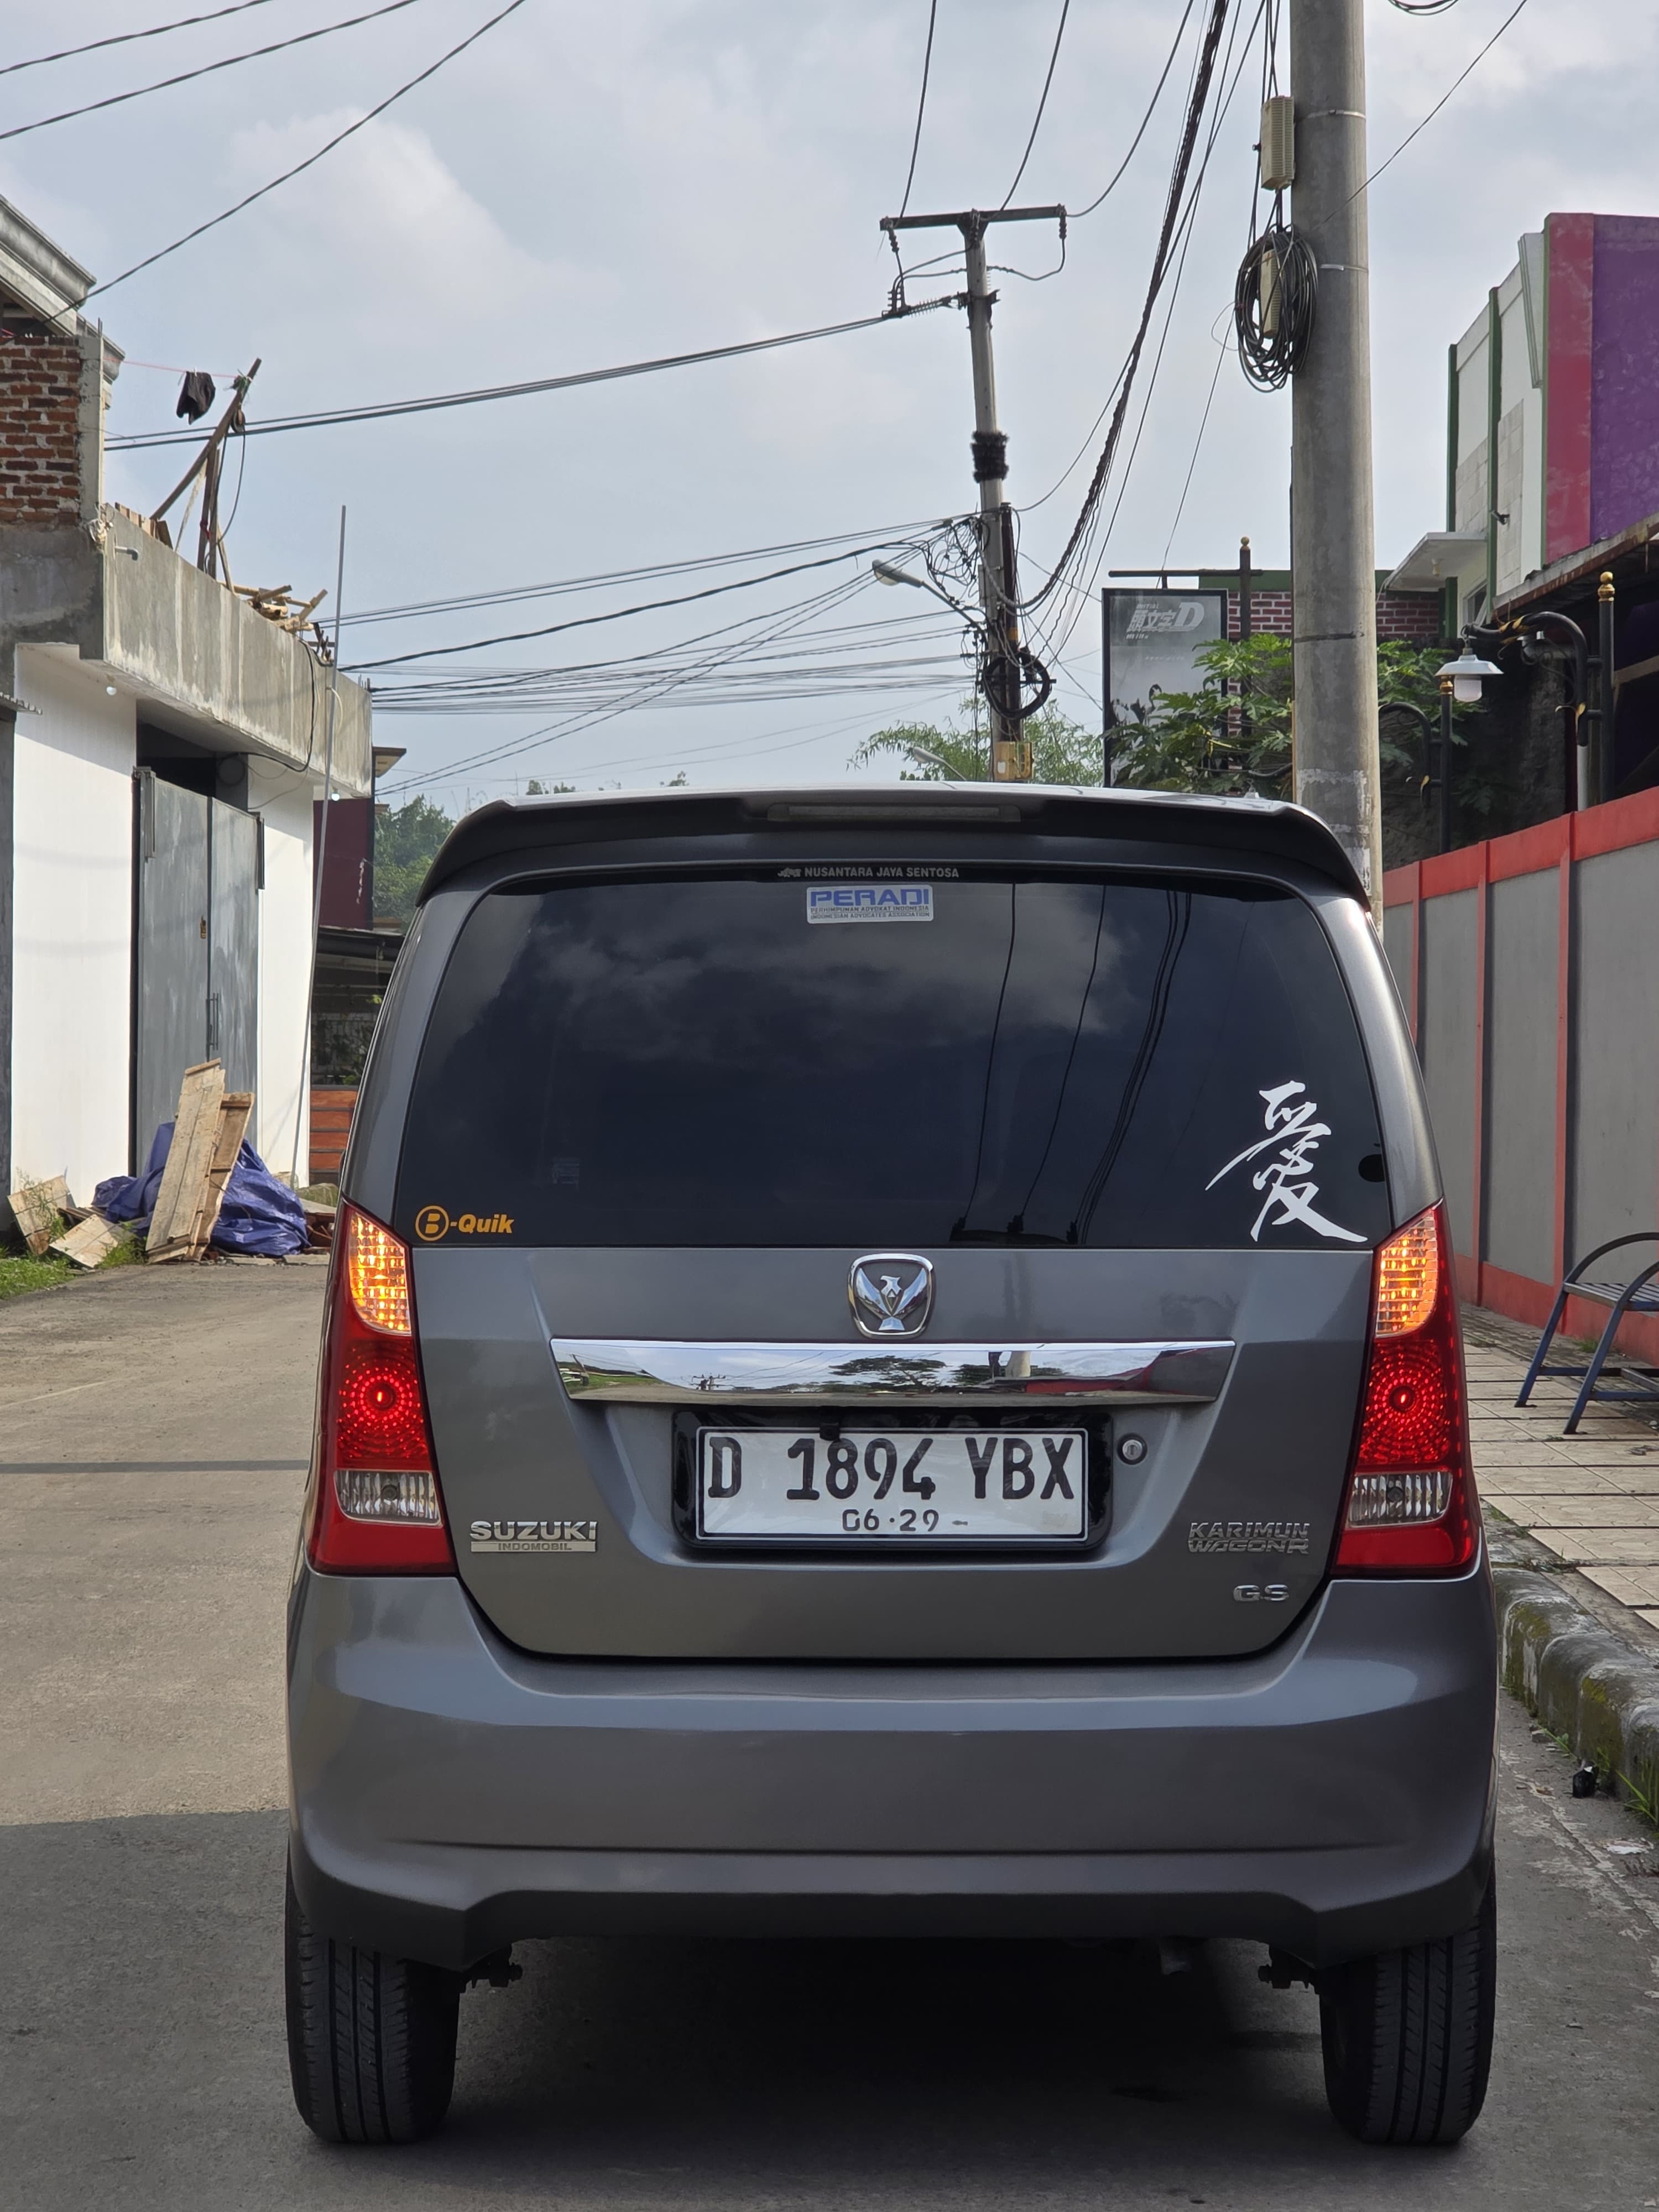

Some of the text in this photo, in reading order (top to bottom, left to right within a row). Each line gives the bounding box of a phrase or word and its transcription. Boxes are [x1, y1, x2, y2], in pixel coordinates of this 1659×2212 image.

[805, 867, 959, 878] NUSANTARA JAYA SENTOSA
[811, 889, 929, 906] PERADI
[1205, 1081, 1368, 1243] 愛
[415, 1205, 514, 1241] B-Quik
[708, 1437, 1074, 1500] D 1894 YBX
[470, 1521, 597, 1540] SUZUKI
[1189, 1522, 1310, 1538] KARIMUN
[1233, 1584, 1289, 1601] GS
